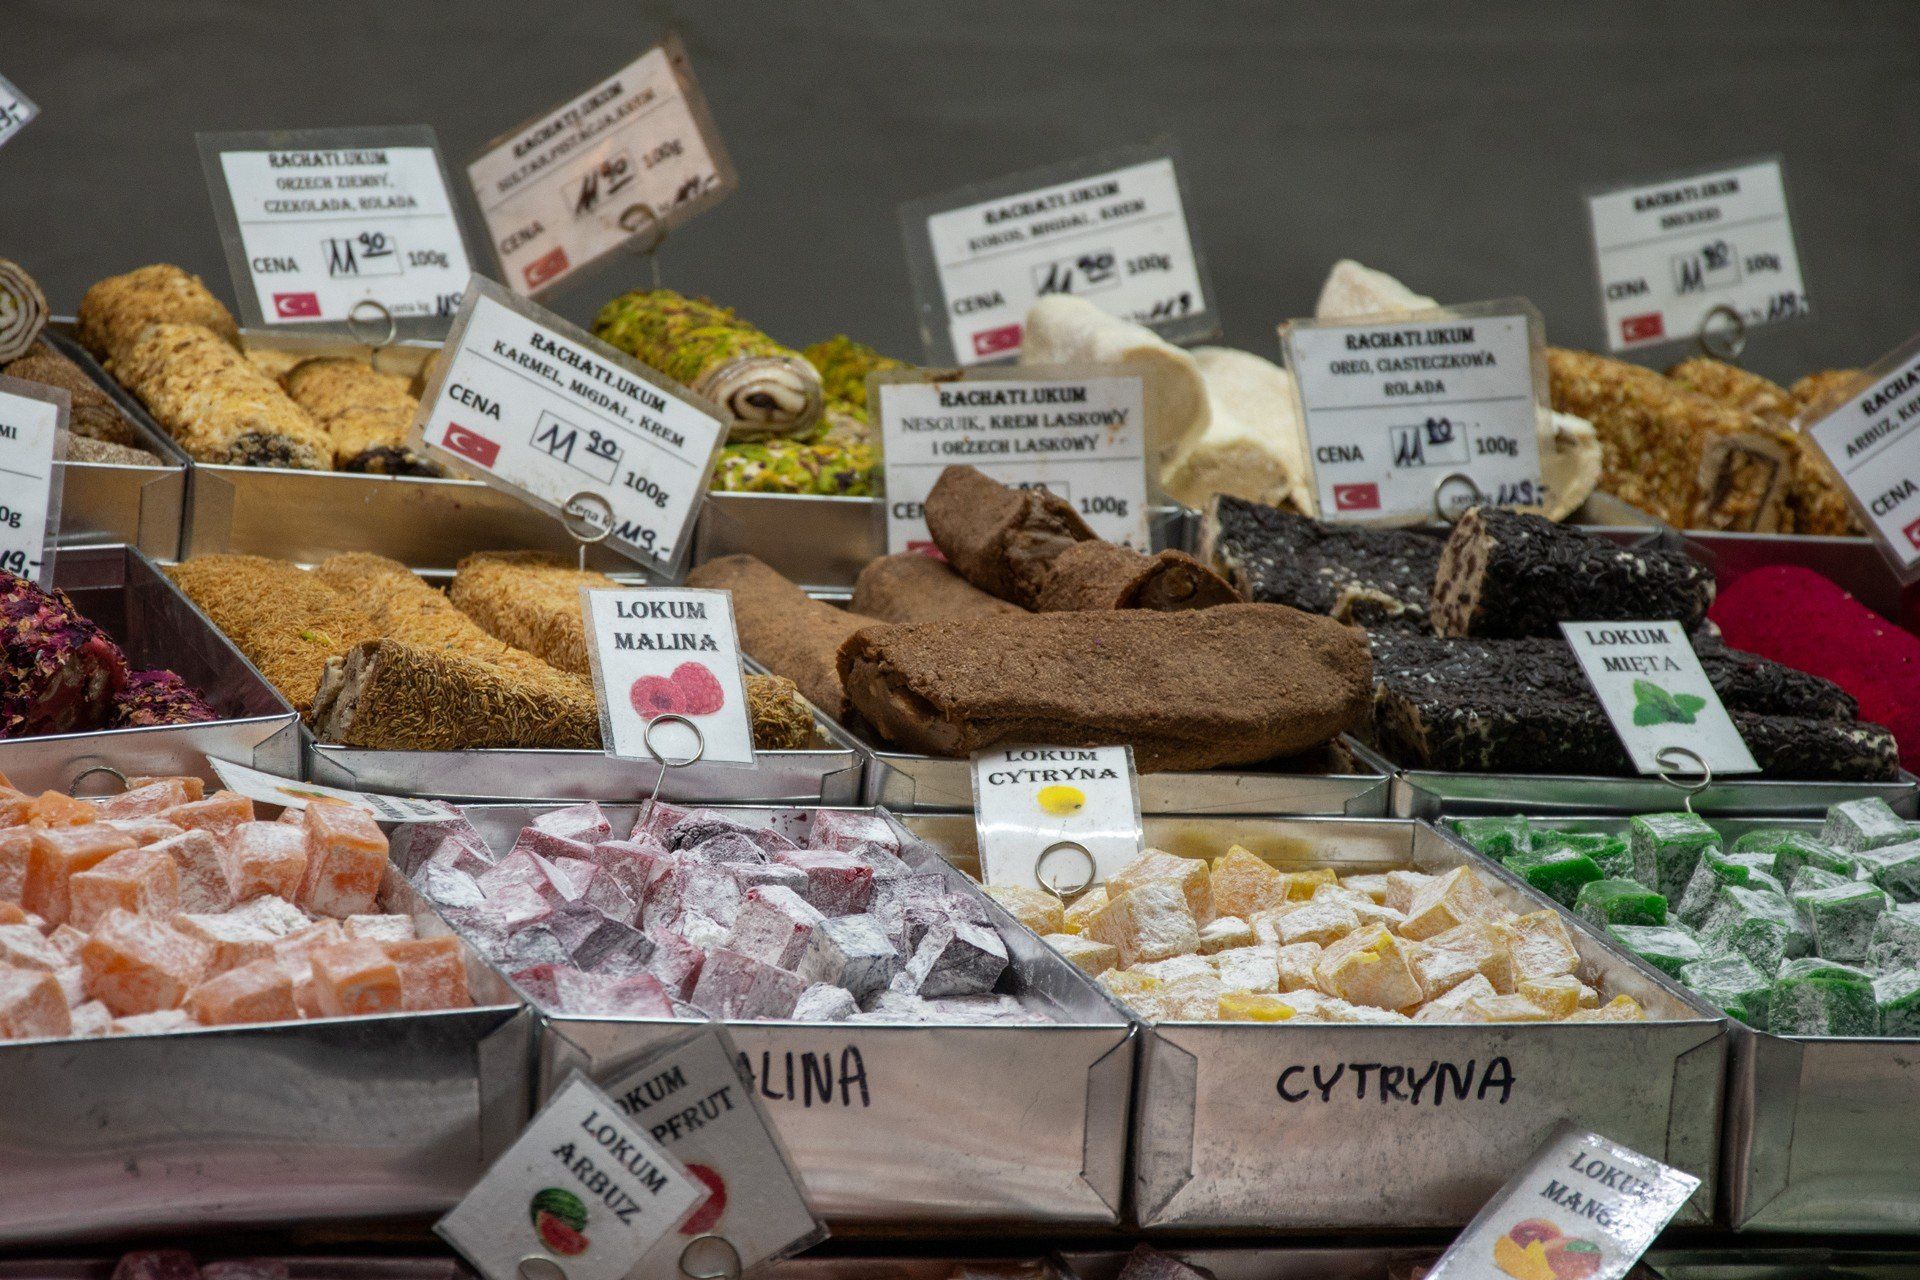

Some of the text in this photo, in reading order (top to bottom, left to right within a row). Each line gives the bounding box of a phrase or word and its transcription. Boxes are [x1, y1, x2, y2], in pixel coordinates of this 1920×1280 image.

[253, 256, 300, 275] CENA
[406, 250, 450, 269] 100g
[952, 289, 1006, 317] CENA
[1125, 252, 1173, 278] 100g
[492, 339, 566, 388] KARMEL,
[638, 415, 687, 449] KREM
[1384, 379, 1446, 397] ROLADA
[1860, 362, 1920, 418] RACHA
[989, 412, 1039, 431] KREM
[1042, 407, 1130, 430] LASKOWY
[1845, 396, 1920, 459] ARBUZ, KR
[448, 382, 502, 422] CENA
[623, 470, 671, 510] 100g
[942, 437, 1011, 456] ORZECH
[1014, 432, 1100, 454] LASKOWY
[1316, 444, 1365, 465] CENA
[1475, 435, 1520, 458] 100g
[1080, 496, 1129, 518] 100g
[1870, 478, 1920, 518] CENA
[616, 600, 708, 620] LOKUM
[614, 632, 720, 652] MALINA
[1584, 628, 1671, 646] LOKUM
[1005, 750, 1099, 763] LOKUM
[988, 766, 1119, 787] CYTRYNA
[1276, 1055, 1517, 1107] CYTRYNA
[579, 1108, 669, 1198] LOKUM
[551, 1139, 646, 1228] ARBUZ
[1539, 1178, 1632, 1229] MANG
